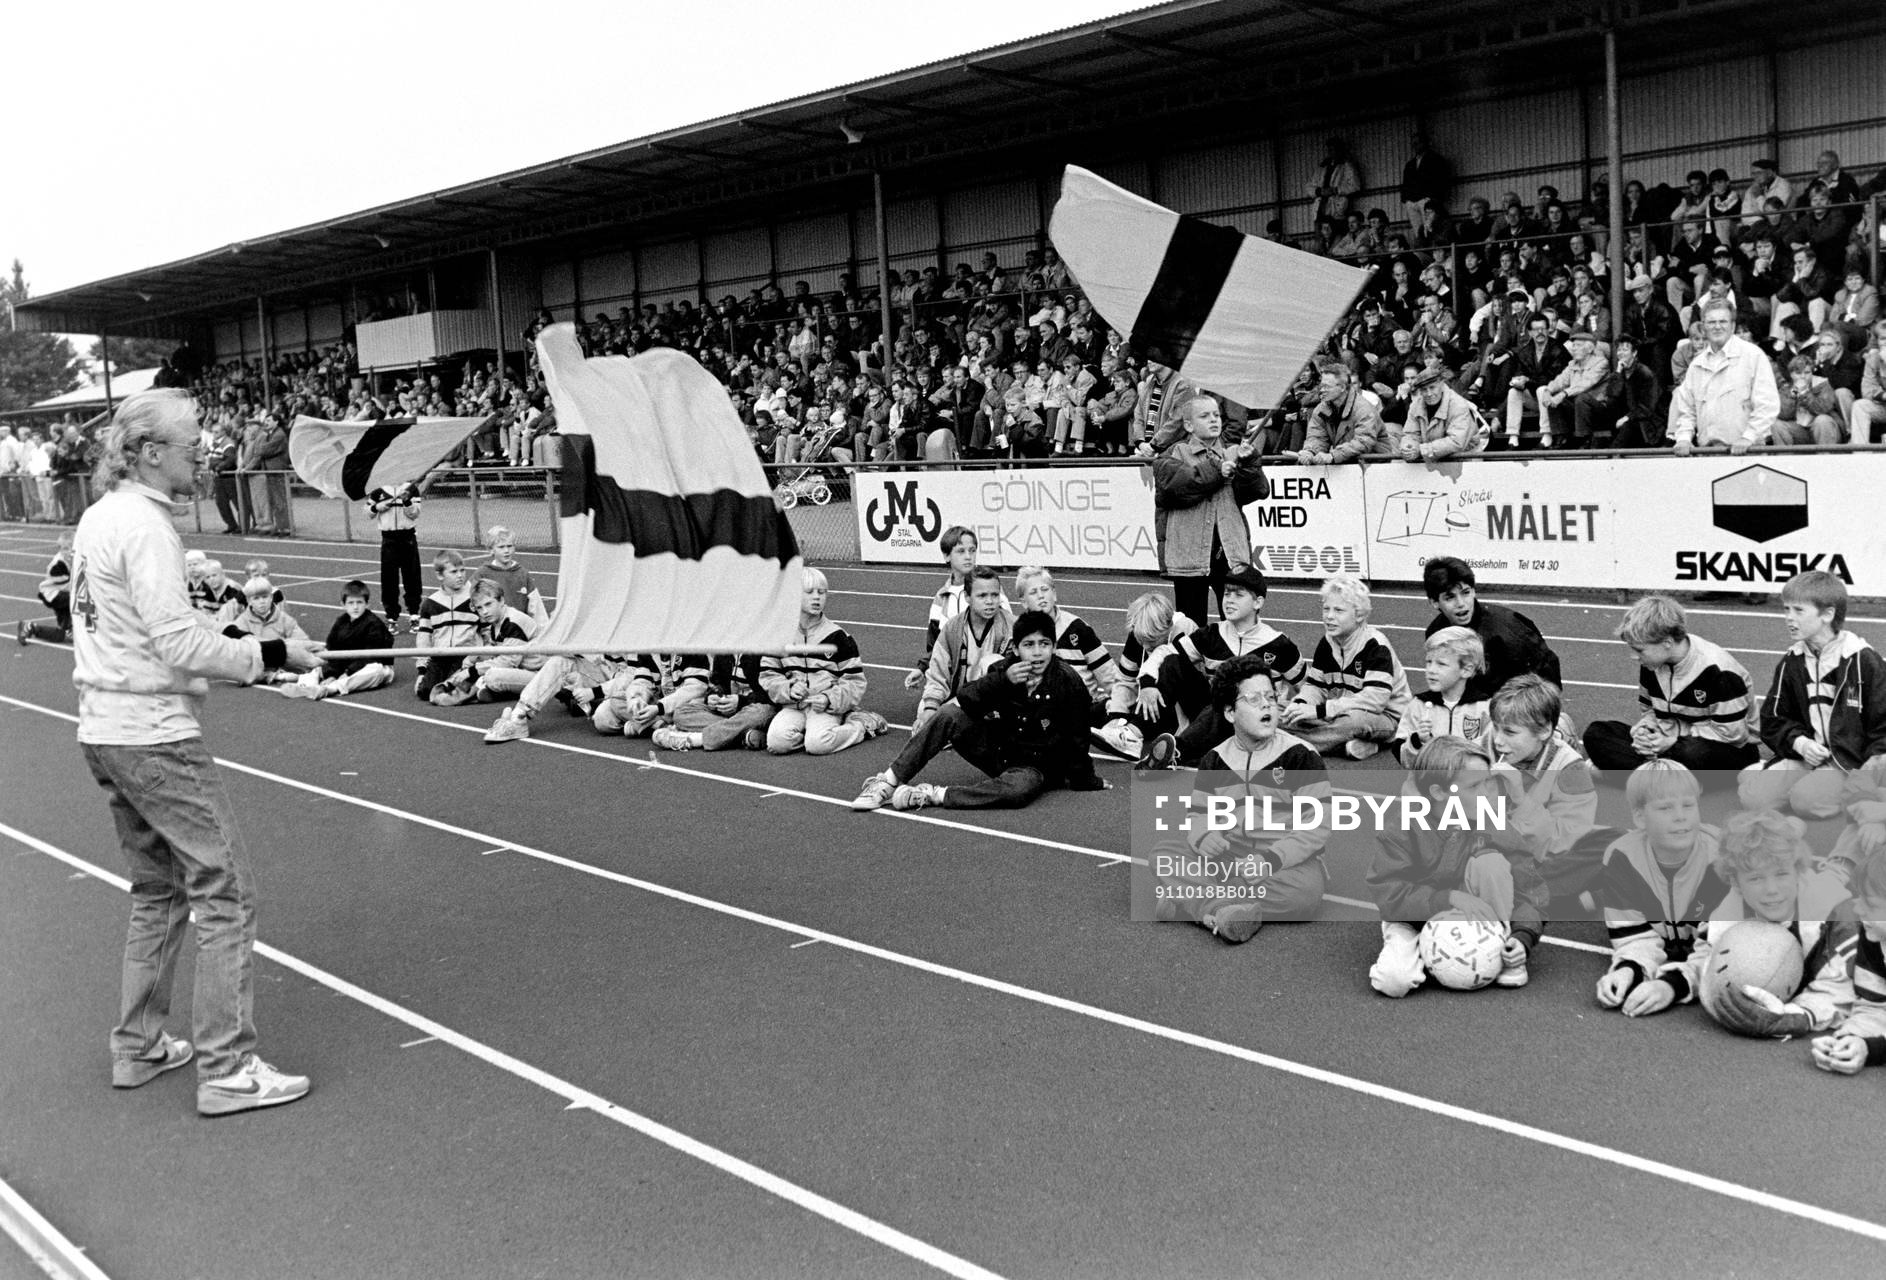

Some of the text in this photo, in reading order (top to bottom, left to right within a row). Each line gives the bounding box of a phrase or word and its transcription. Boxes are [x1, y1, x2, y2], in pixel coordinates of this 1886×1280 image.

[981, 474, 1112, 512] GÖINGE
[1270, 477, 1331, 500] LERA
[1258, 506, 1307, 528] MED
[1487, 493, 1599, 541] MÅLET
[891, 538, 922, 547] BYGGARNA
[969, 524, 1157, 557] EKANISKA
[1252, 545, 1361, 573] KWOOL
[1519, 559, 1530, 570] Tel
[1532, 560, 1545, 570] 124
[1547, 560, 1559, 571] 30
[1675, 551, 1854, 585] SKANSKA
